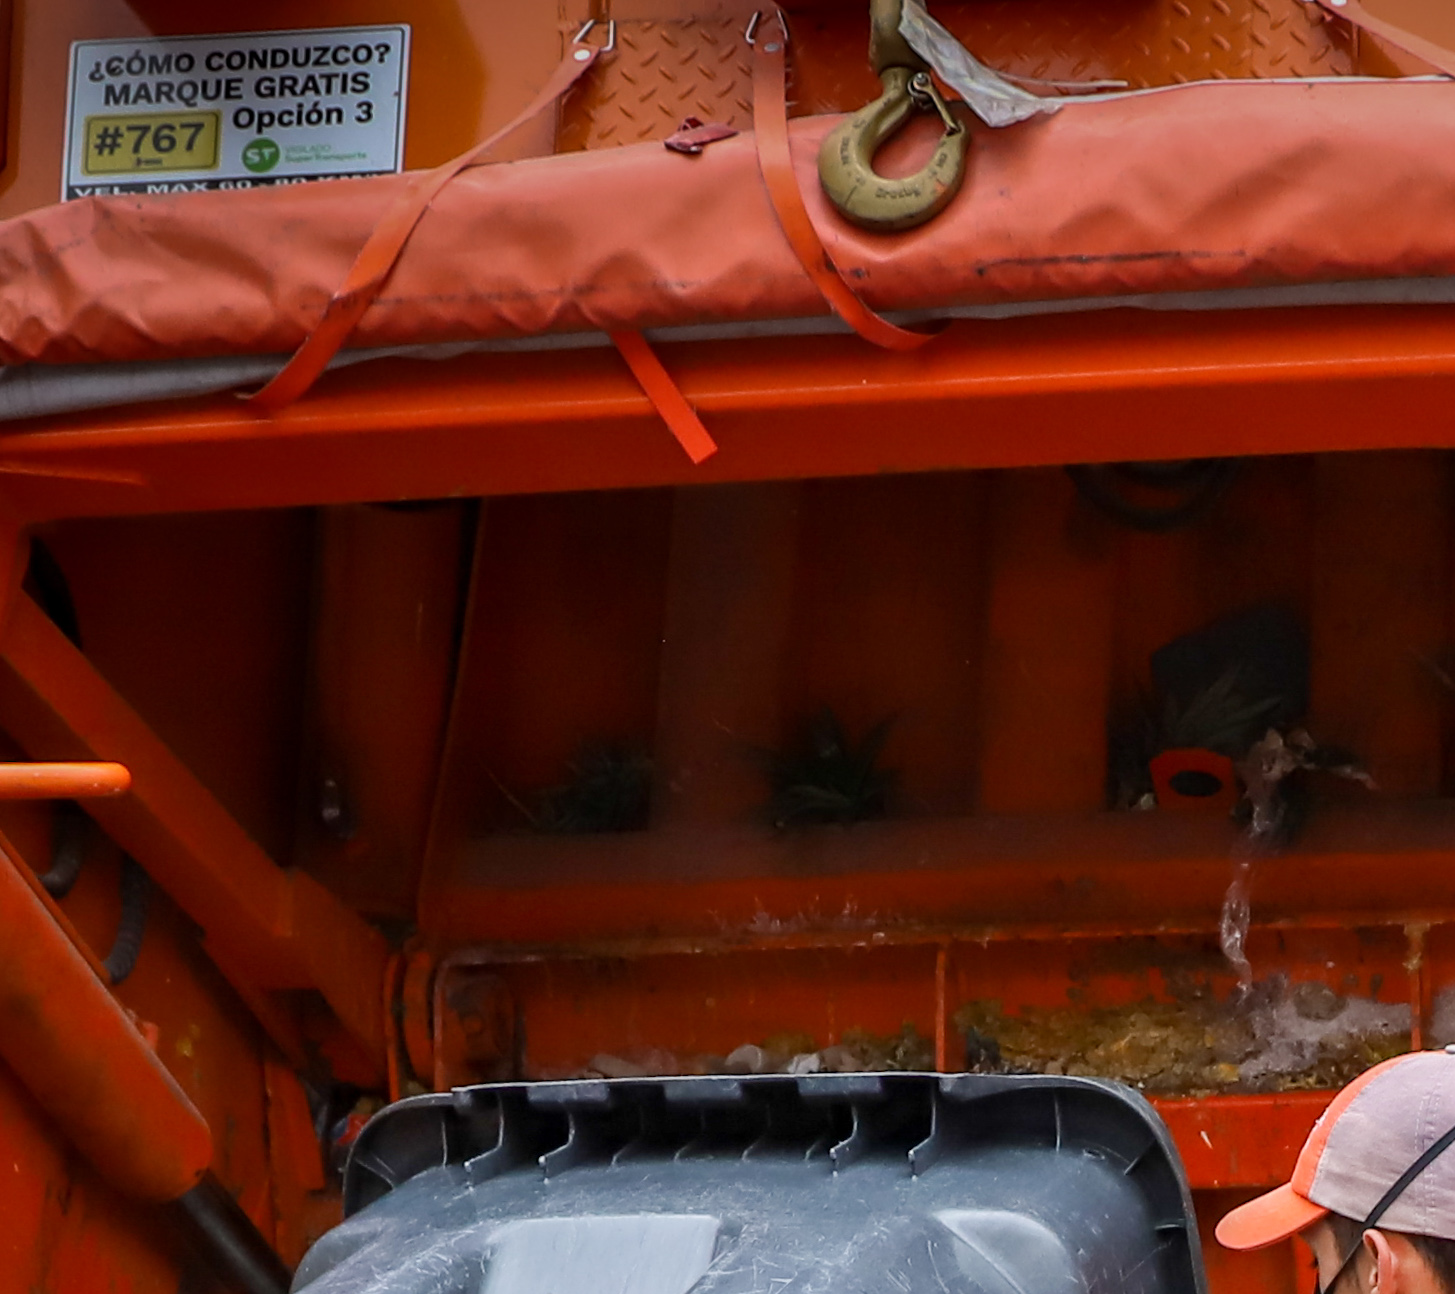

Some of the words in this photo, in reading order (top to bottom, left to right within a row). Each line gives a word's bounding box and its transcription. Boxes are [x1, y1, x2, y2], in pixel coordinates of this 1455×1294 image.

[88, 50, 196, 82] ¿CÓMO
[204, 43, 392, 73] CONDUZCO?
[103, 78, 243, 107] MARQUE
[254, 71, 371, 99] GRATIS
[232, 103, 343, 134] Opción
[354, 101, 374, 124] 3
[94, 122, 205, 156] #767
[146, 182, 210, 195] MAX
